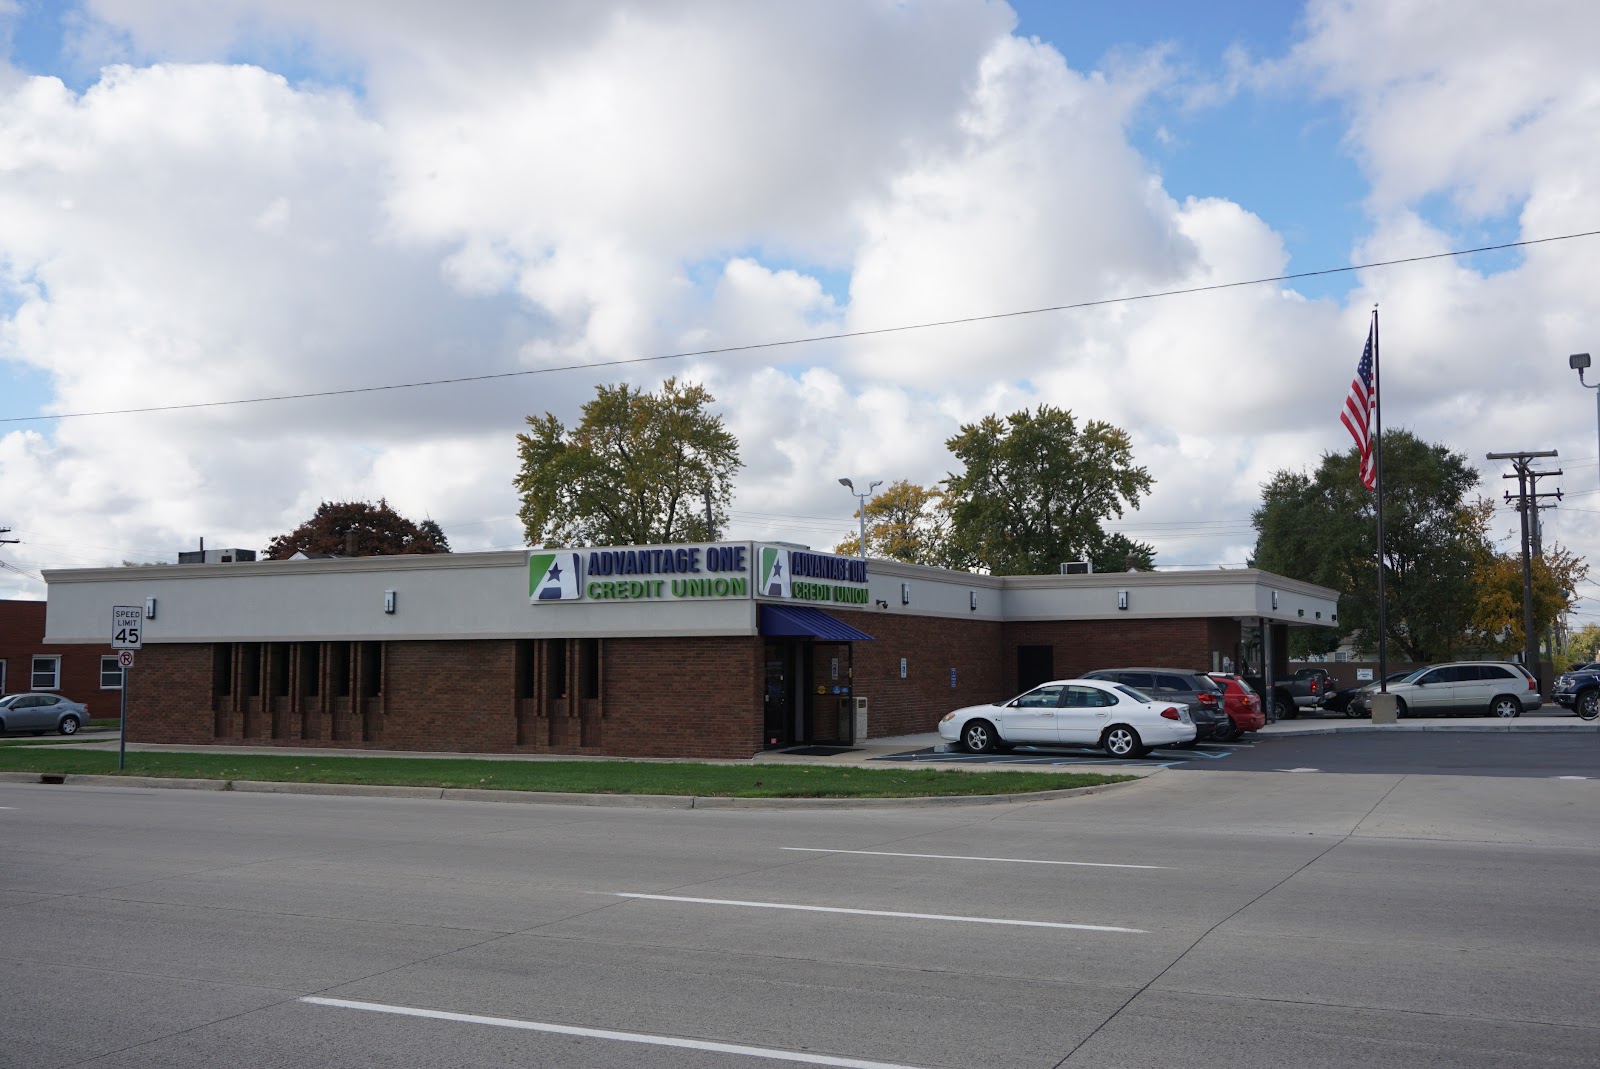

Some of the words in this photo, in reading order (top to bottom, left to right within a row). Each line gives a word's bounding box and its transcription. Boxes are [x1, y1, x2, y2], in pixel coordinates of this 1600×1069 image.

[587, 548, 700, 576] ADVANTAGE
[706, 546, 746, 572] ONE
[792, 552, 850, 581] ADVANTAGE
[850, 560, 868, 583] ONE
[586, 579, 663, 599] CREDIT
[671, 577, 746, 597] UNION
[792, 582, 834, 601] CREDIT
[835, 586, 869, 604] UNION
[115, 628, 138, 643] 45
